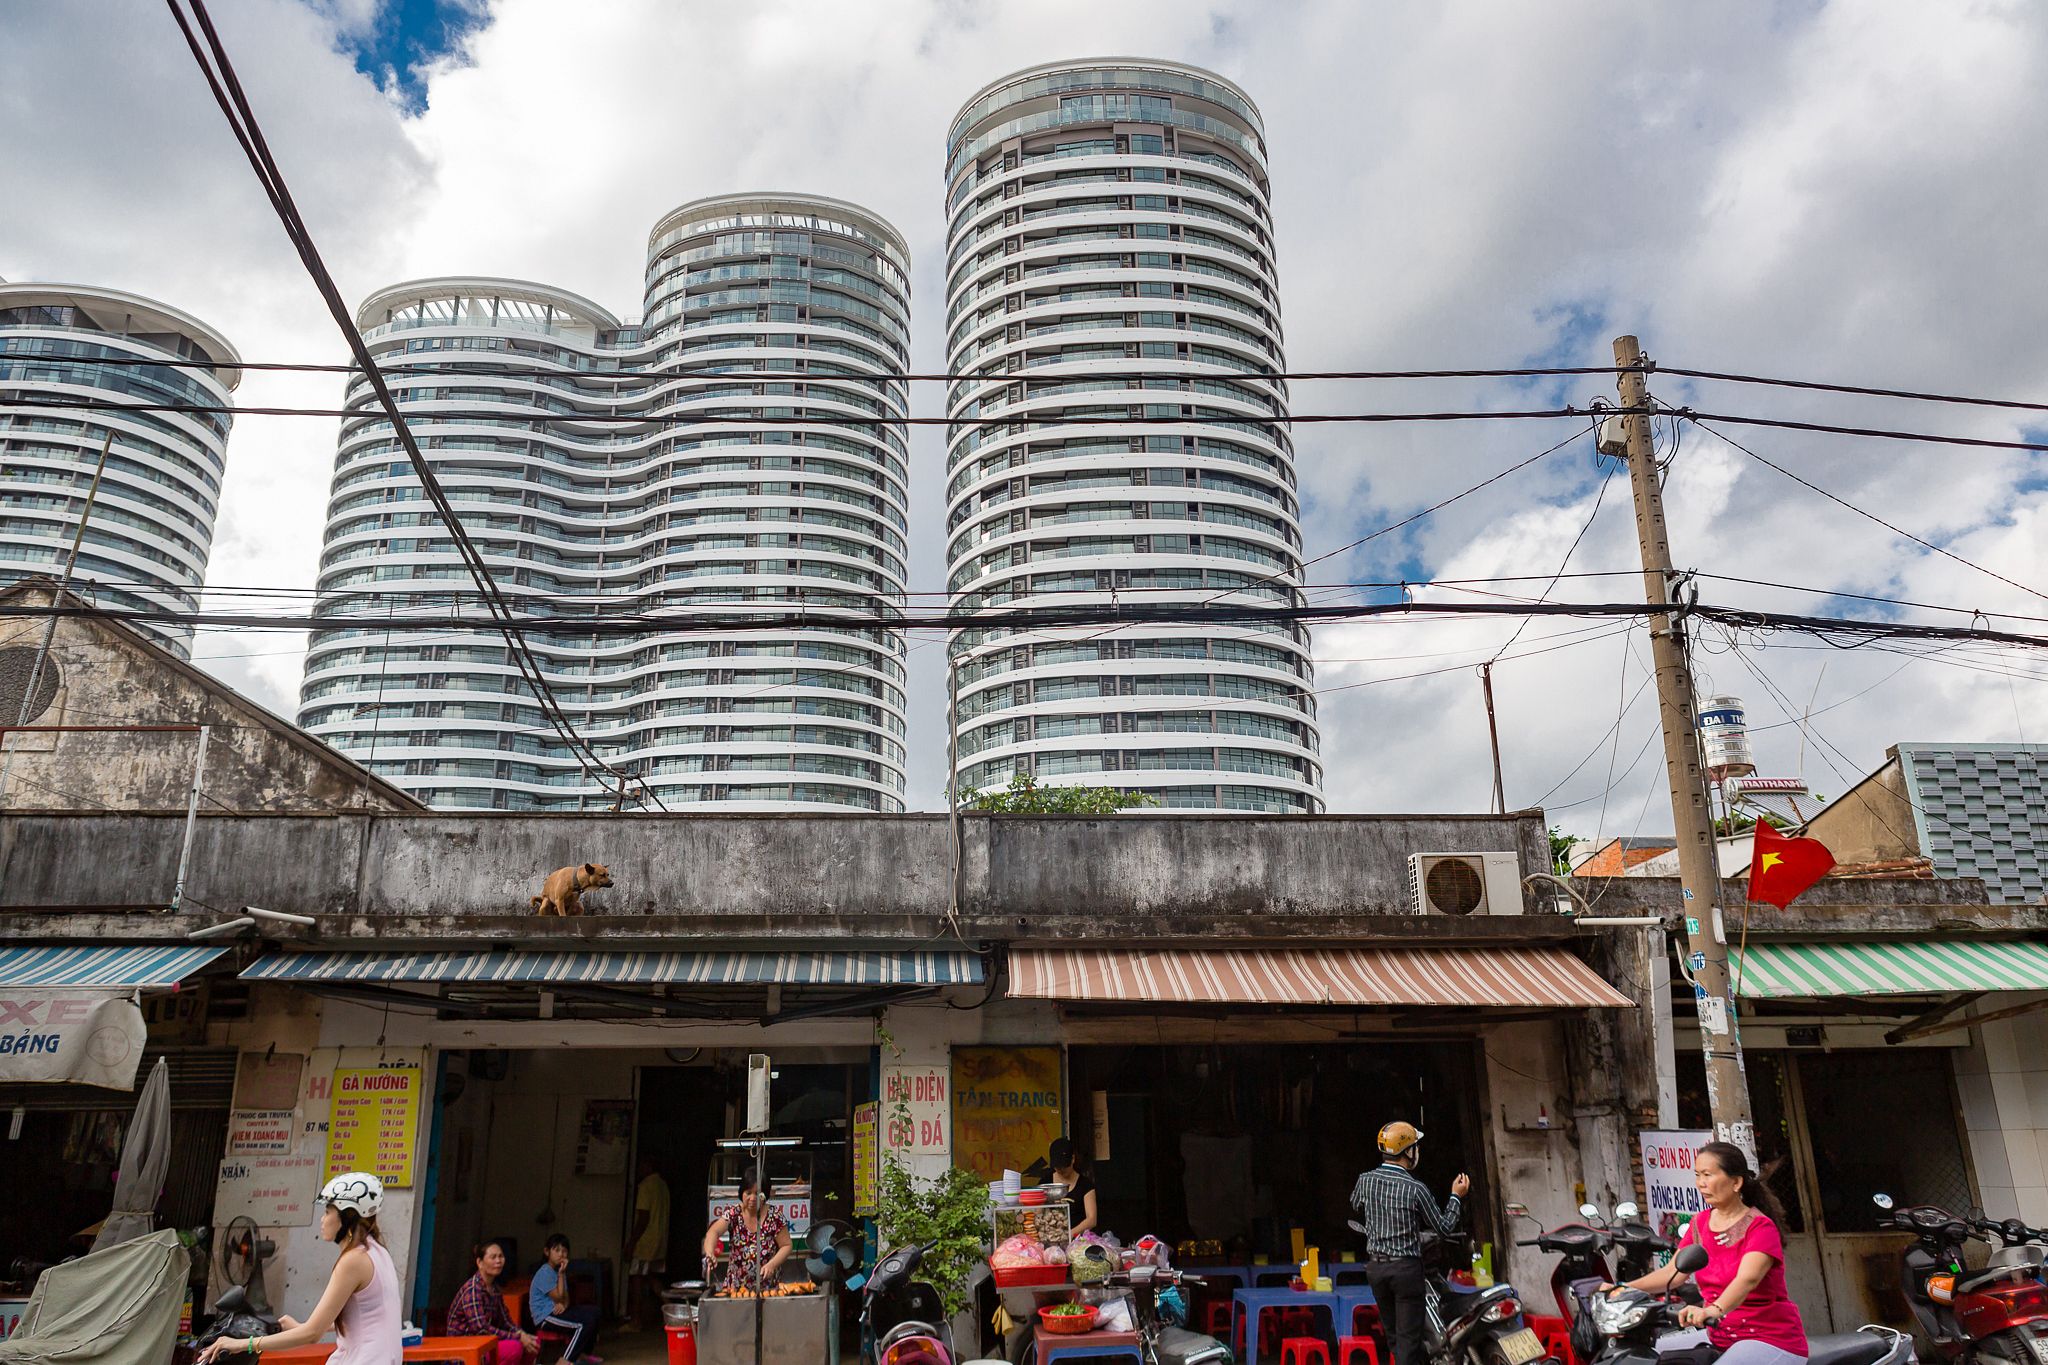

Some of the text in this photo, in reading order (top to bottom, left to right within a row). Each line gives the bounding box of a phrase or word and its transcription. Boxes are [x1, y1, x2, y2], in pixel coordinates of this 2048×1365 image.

[342, 1074, 408, 1090] GÀ NƯỚNG
[916, 1070, 944, 1107] ĐIỆN
[957, 1086, 1057, 1108] TÂN TRANG
[306, 1122, 315, 1132] 87
[921, 1114, 943, 1145] ĐÁ
[1659, 1141, 1677, 1169] BÚN
[1678, 1142, 1691, 1169] BÒ
[790, 1201, 809, 1219] GÀ
[1674, 1186, 1685, 1211] BA
[1686, 1187, 1700, 1212] GIA
